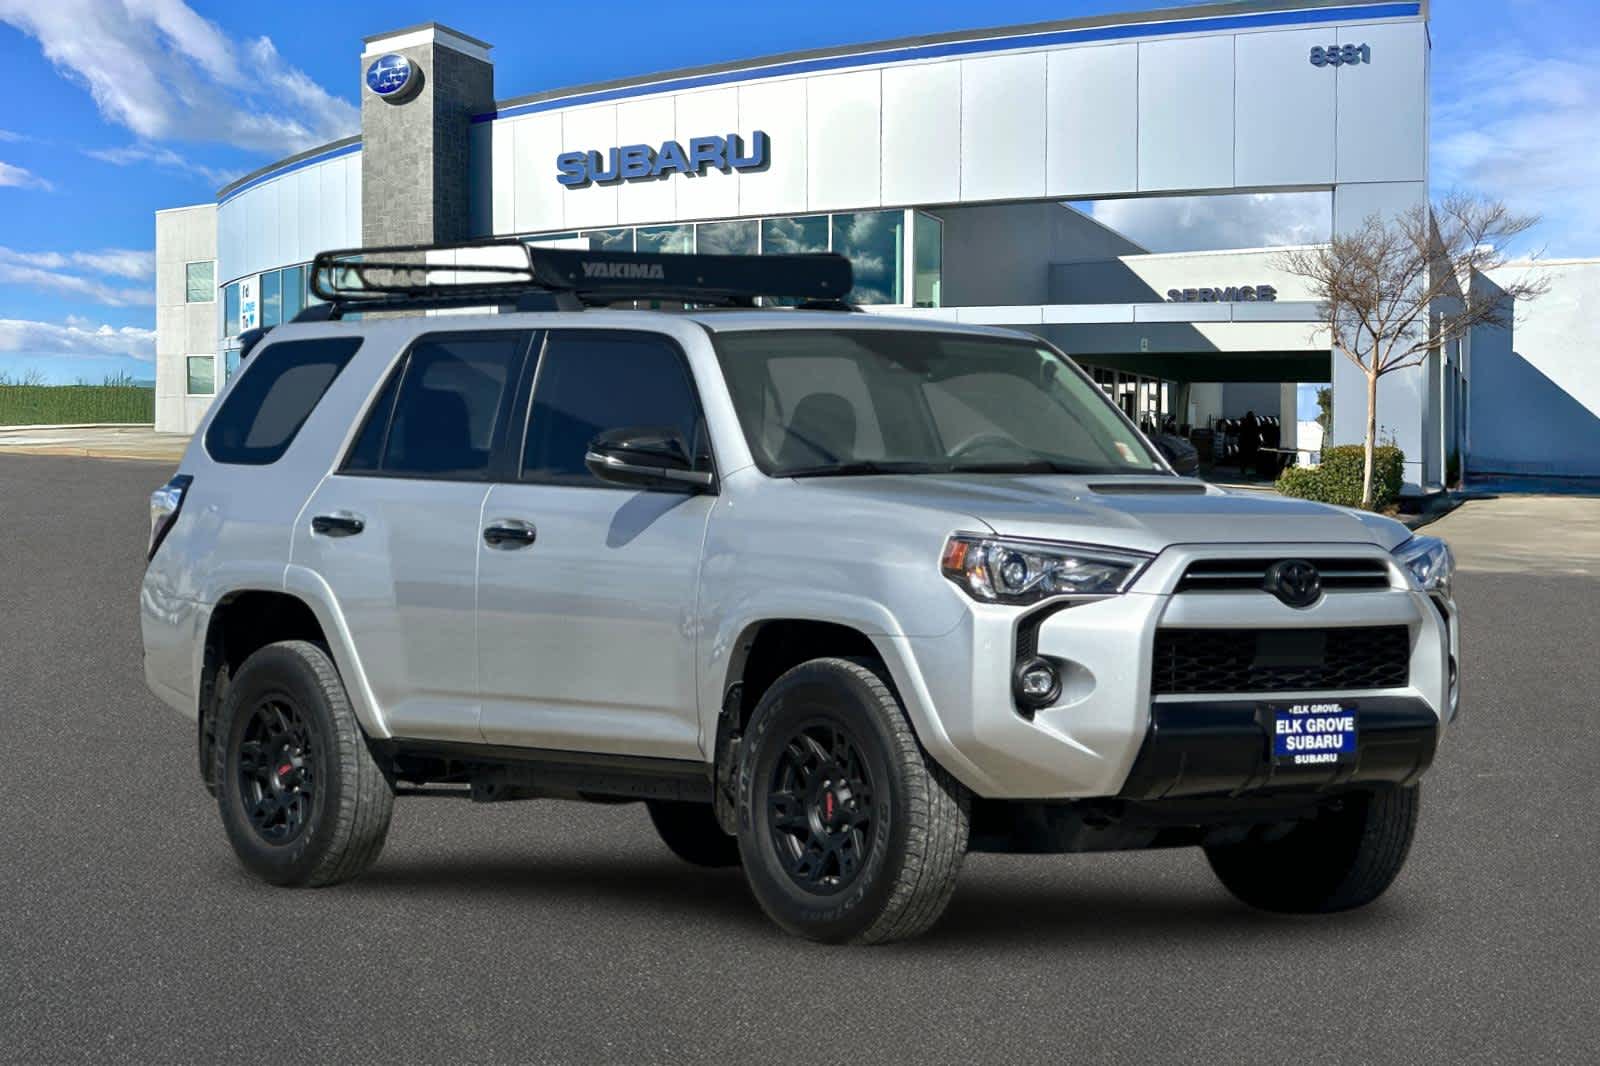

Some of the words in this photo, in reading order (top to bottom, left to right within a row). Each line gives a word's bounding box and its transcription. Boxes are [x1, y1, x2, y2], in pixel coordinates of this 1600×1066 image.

[556, 130, 771, 190] SUBARU
[582, 262, 665, 279] YAKIMA
[1166, 284, 1278, 303] SERVICE
[1293, 705, 1309, 714] ELK
[1311, 704, 1339, 713] GROVE
[1276, 719, 1303, 734] ELK
[1306, 717, 1355, 733] GROVE
[1286, 734, 1343, 750] SUBARU
[1295, 753, 1338, 764] SUBARU
